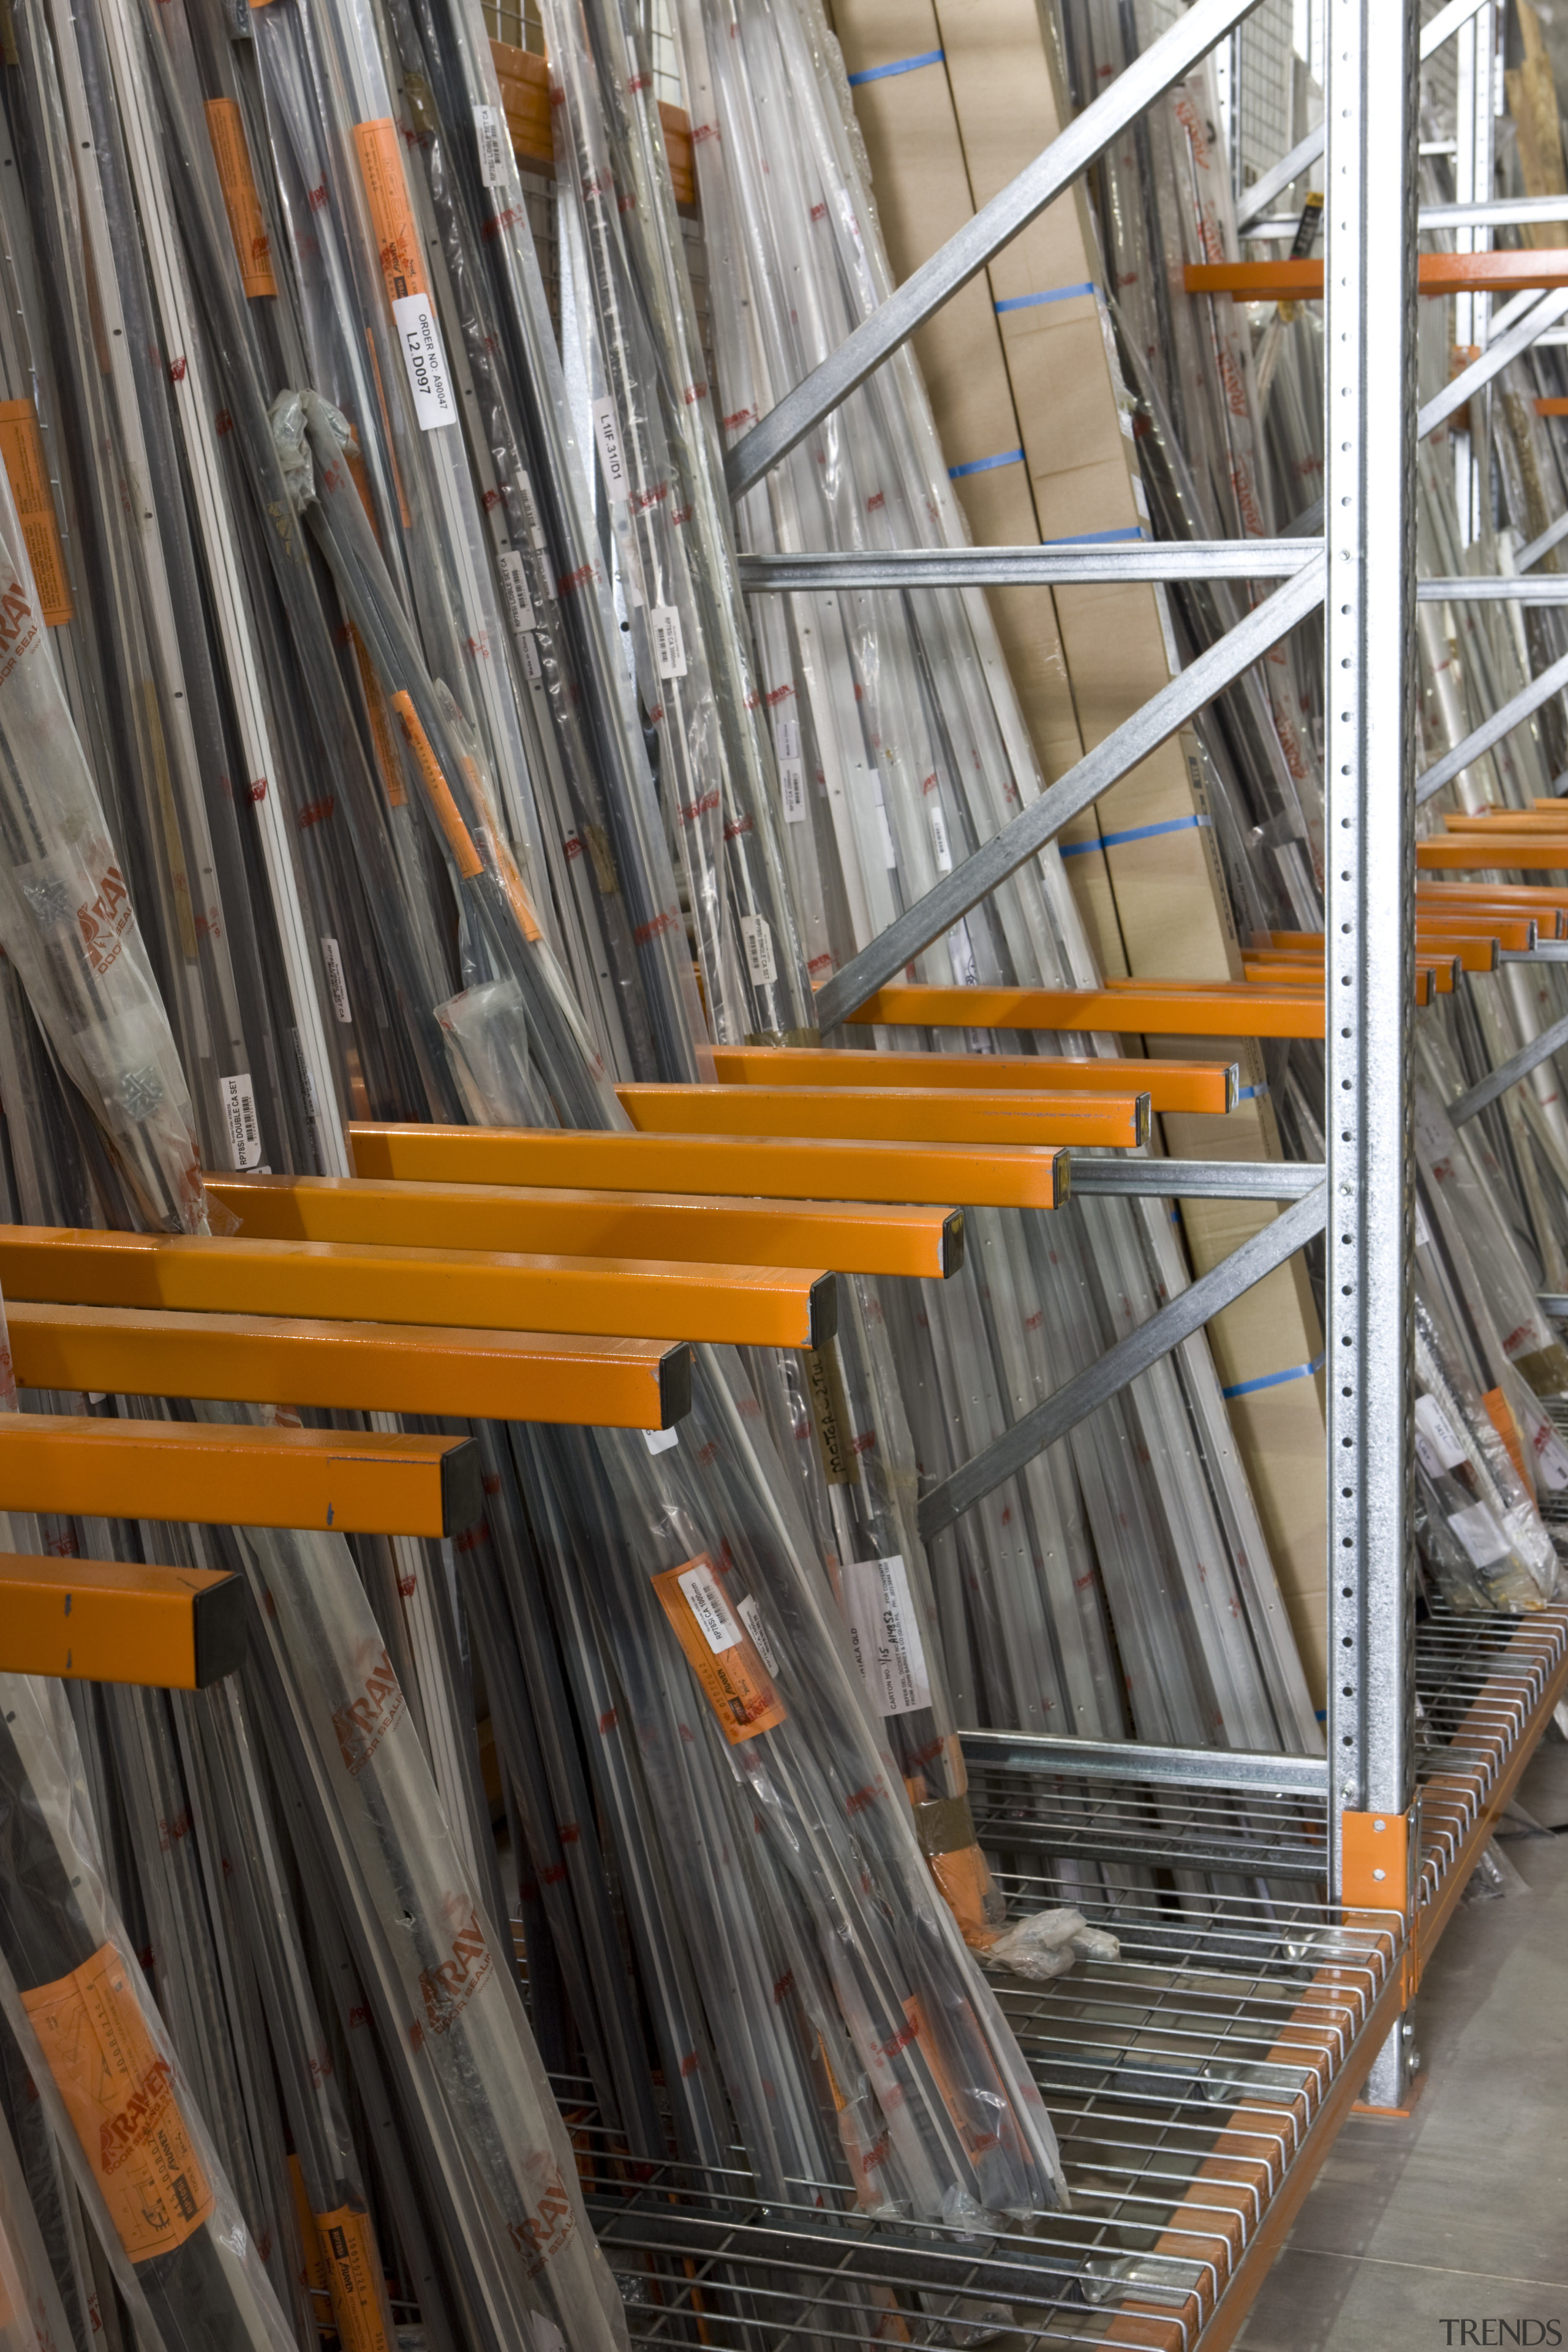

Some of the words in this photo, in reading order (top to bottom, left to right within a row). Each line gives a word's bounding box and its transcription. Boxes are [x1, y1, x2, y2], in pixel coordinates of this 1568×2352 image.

[481, 110, 488, 119] CA
[419, 314, 434, 350] ORDER
[407, 331, 431, 394] L2.D097
[428, 353, 439, 372] NO:
[433, 375, 448, 409] A90047
[499, 557, 507, 568] CA
[505, 581, 516, 605] L/DBLE
[511, 605, 521, 627] RP78Si
[339, 1008, 344, 1017] CA
[228, 1080, 237, 1094] SET
[231, 1095, 239, 1106] CA
[232, 1108, 243, 1138] DOUBLE
[236, 1139, 247, 1165] RP78Si
[877, 1562, 888, 1592] CONTENTS
[690, 1581, 706, 1608] 1000mm
[702, 1607, 711, 1618] CA
[706, 1616, 723, 1640] RP78Si
[850, 1627, 859, 1645] QLD
[895, 1621, 903, 1637] (QLD)
[756, 1635, 763, 1646] CA
[898, 1637, 904, 1645] CO
[895, 1653, 904, 1675] DOCKET
[901, 1651, 910, 1673] BARNES
[716, 1667, 735, 1697] RAVEN
[887, 1680, 897, 1709] CARTON
[902, 1688, 910, 1706] REFER
[732, 1699, 746, 1722] RP78Si
[349, 1738, 380, 1776] DOOR
[110, 2052, 173, 2144] RAVEN
[104, 2142, 135, 2180] DOOR
[130, 2102, 164, 2147] SEALING
[154, 2128, 180, 2173] RAVEN
[184, 2166, 200, 2193] TOOLS
[174, 2179, 195, 2215] RP10Si
[331, 2231, 345, 2255] RP78Si
[344, 2236, 371, 2292] 30050726
[337, 2260, 355, 2293] RAVEN
[351, 2315, 368, 2350] INSTRUCTIONS
